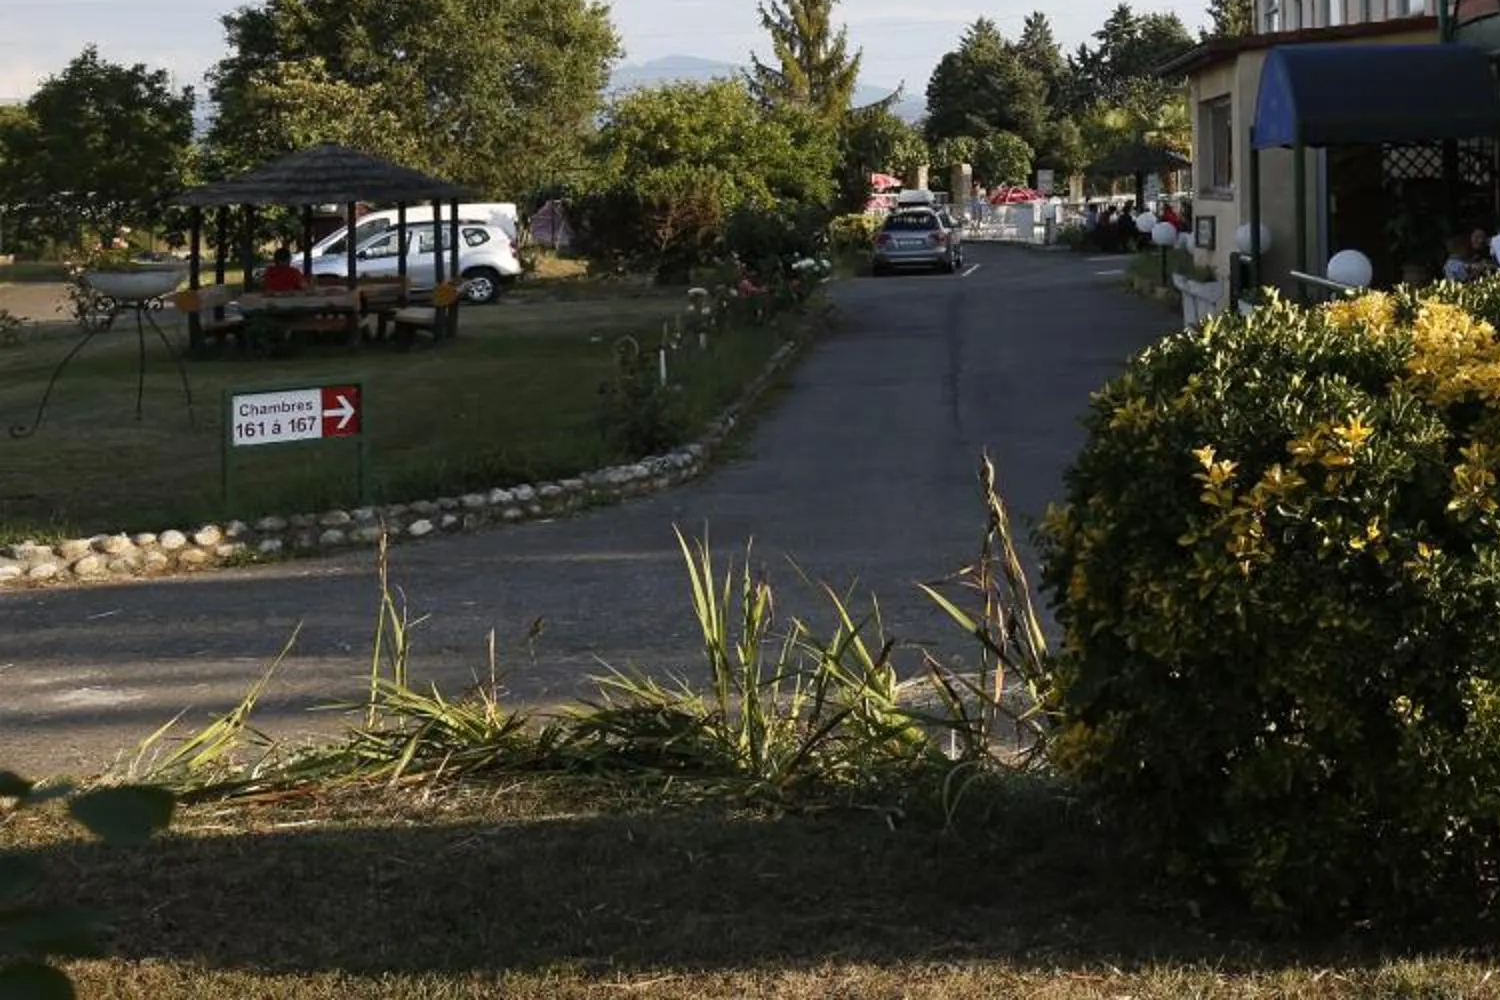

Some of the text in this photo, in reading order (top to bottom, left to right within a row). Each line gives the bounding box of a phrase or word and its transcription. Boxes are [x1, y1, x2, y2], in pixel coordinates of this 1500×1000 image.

[239, 400, 313, 417] Chambres
[235, 422, 265, 438] 161
[288, 416, 317, 433] 167
